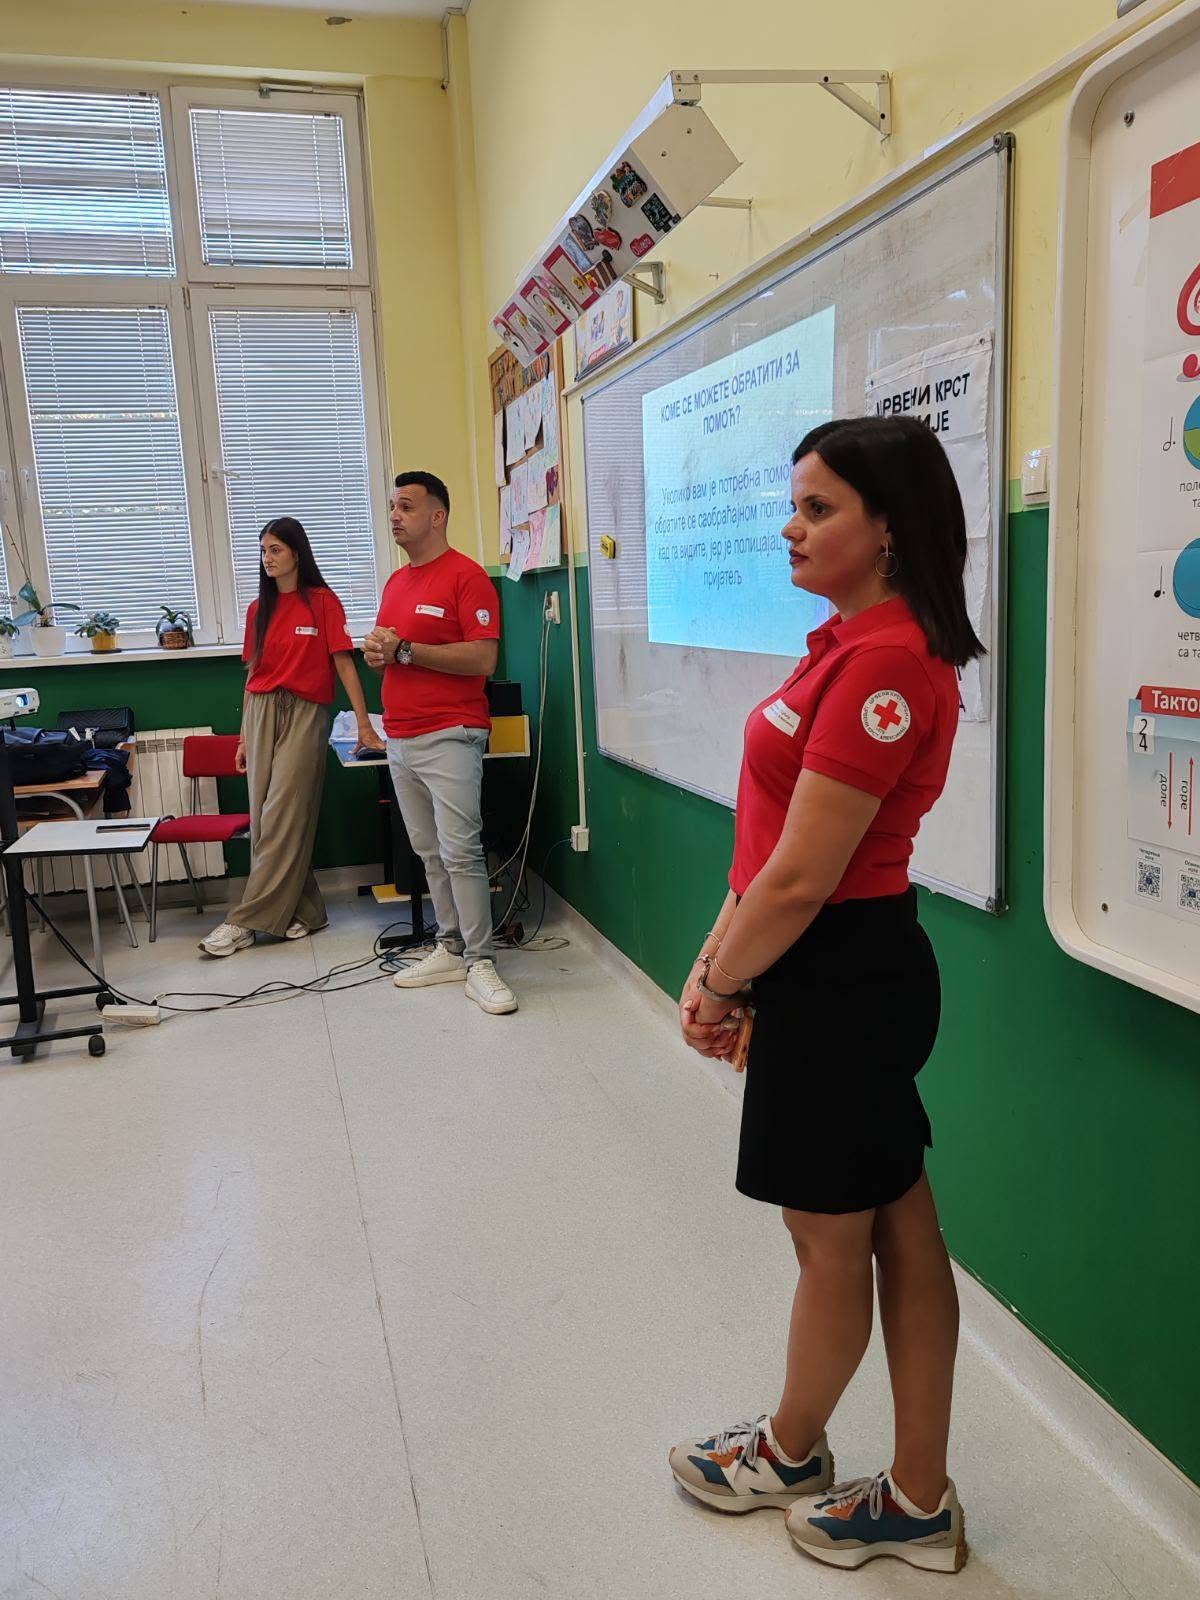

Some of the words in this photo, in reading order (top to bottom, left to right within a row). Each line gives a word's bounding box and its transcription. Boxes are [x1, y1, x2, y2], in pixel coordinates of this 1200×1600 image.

[660, 399, 681, 423] КОМЕ
[682, 395, 692, 414] СЕ
[694, 379, 729, 410] МОЖЕТЕ
[732, 356, 783, 396] ОБРАТИТИ
[785, 349, 800, 375] ЗА
[935, 372, 970, 403] КРСТ
[703, 404, 741, 436] ПОМОЋ?
[693, 482, 707, 500] вам
[708, 476, 717, 501] је
[719, 467, 761, 497] потребна
[1179, 481, 1200, 492] пол
[688, 515, 697, 530] се
[698, 502, 757, 531] саобраћајном
[761, 499, 791, 519] полиц
[723, 535, 732, 561] је
[734, 530, 783, 558] полицајац
[703, 566, 743, 591] пријатељ
[1178, 648, 1189, 658] са
[1151, 689, 1200, 713] Такто
[1139, 718, 1148, 736] 2
[1138, 735, 1148, 752] 4
[1159, 773, 1168, 808] доле
[1180, 780, 1189, 811] горе
